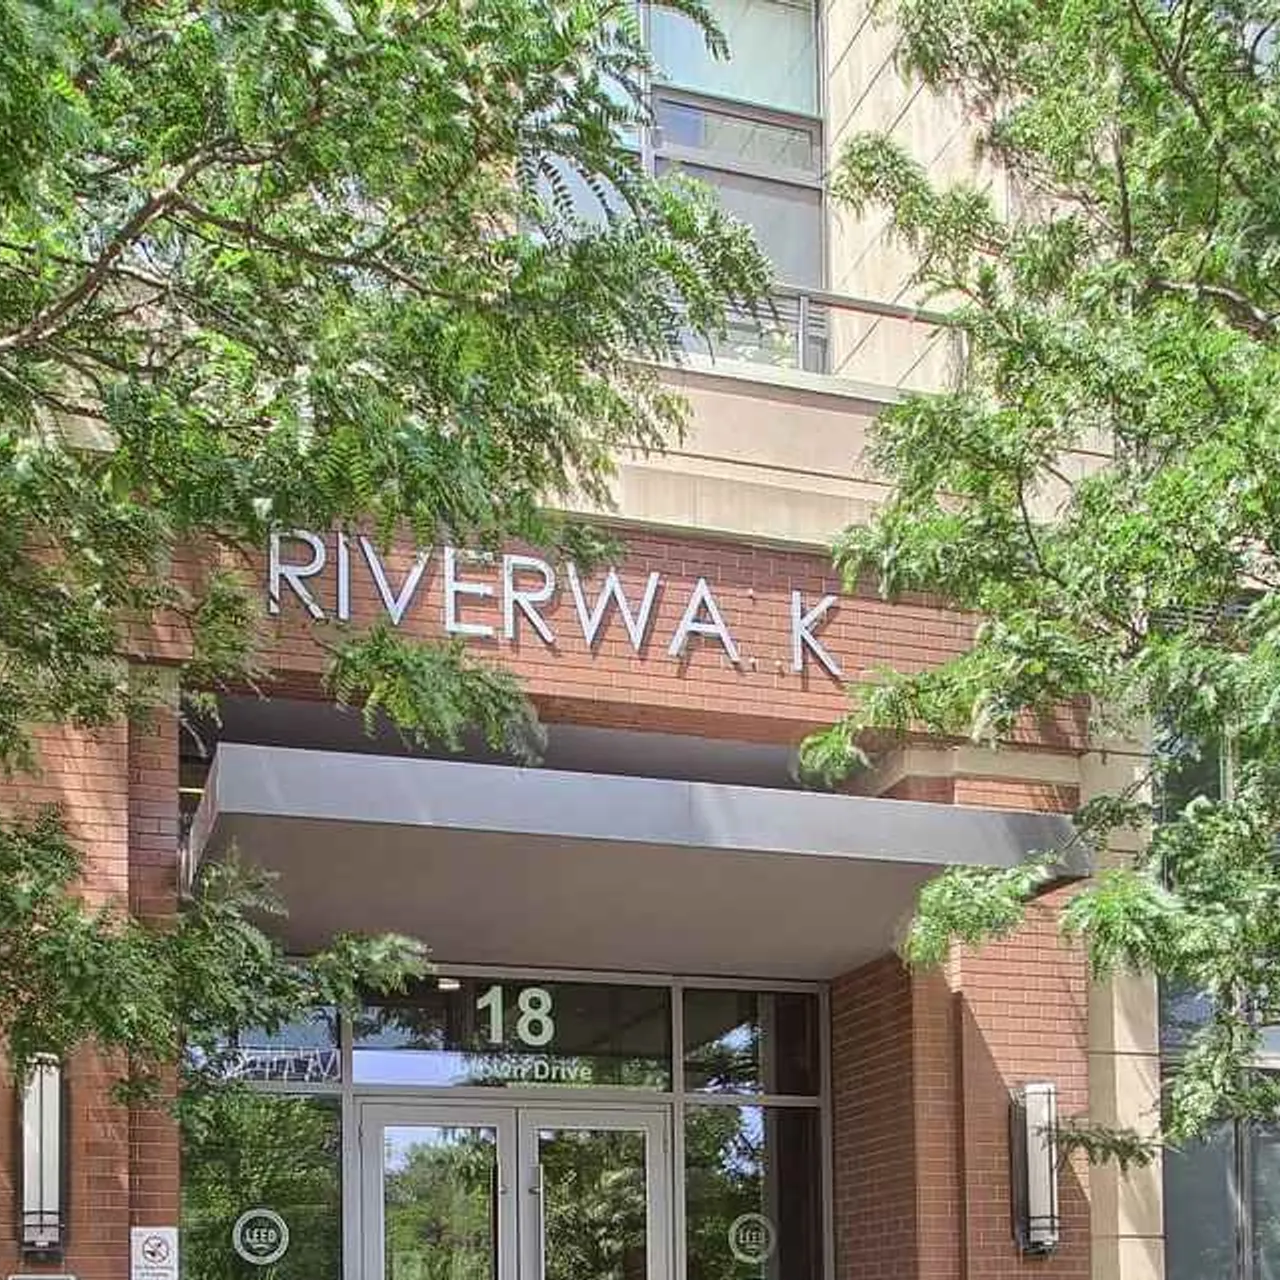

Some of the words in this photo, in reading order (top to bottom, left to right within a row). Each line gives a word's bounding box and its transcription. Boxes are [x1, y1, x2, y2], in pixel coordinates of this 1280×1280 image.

[268, 526, 844, 678] RIVERWAK
[476, 985, 555, 1047] 18
[533, 1060, 593, 1081] Drive
[245, 1228, 277, 1243] LEED
